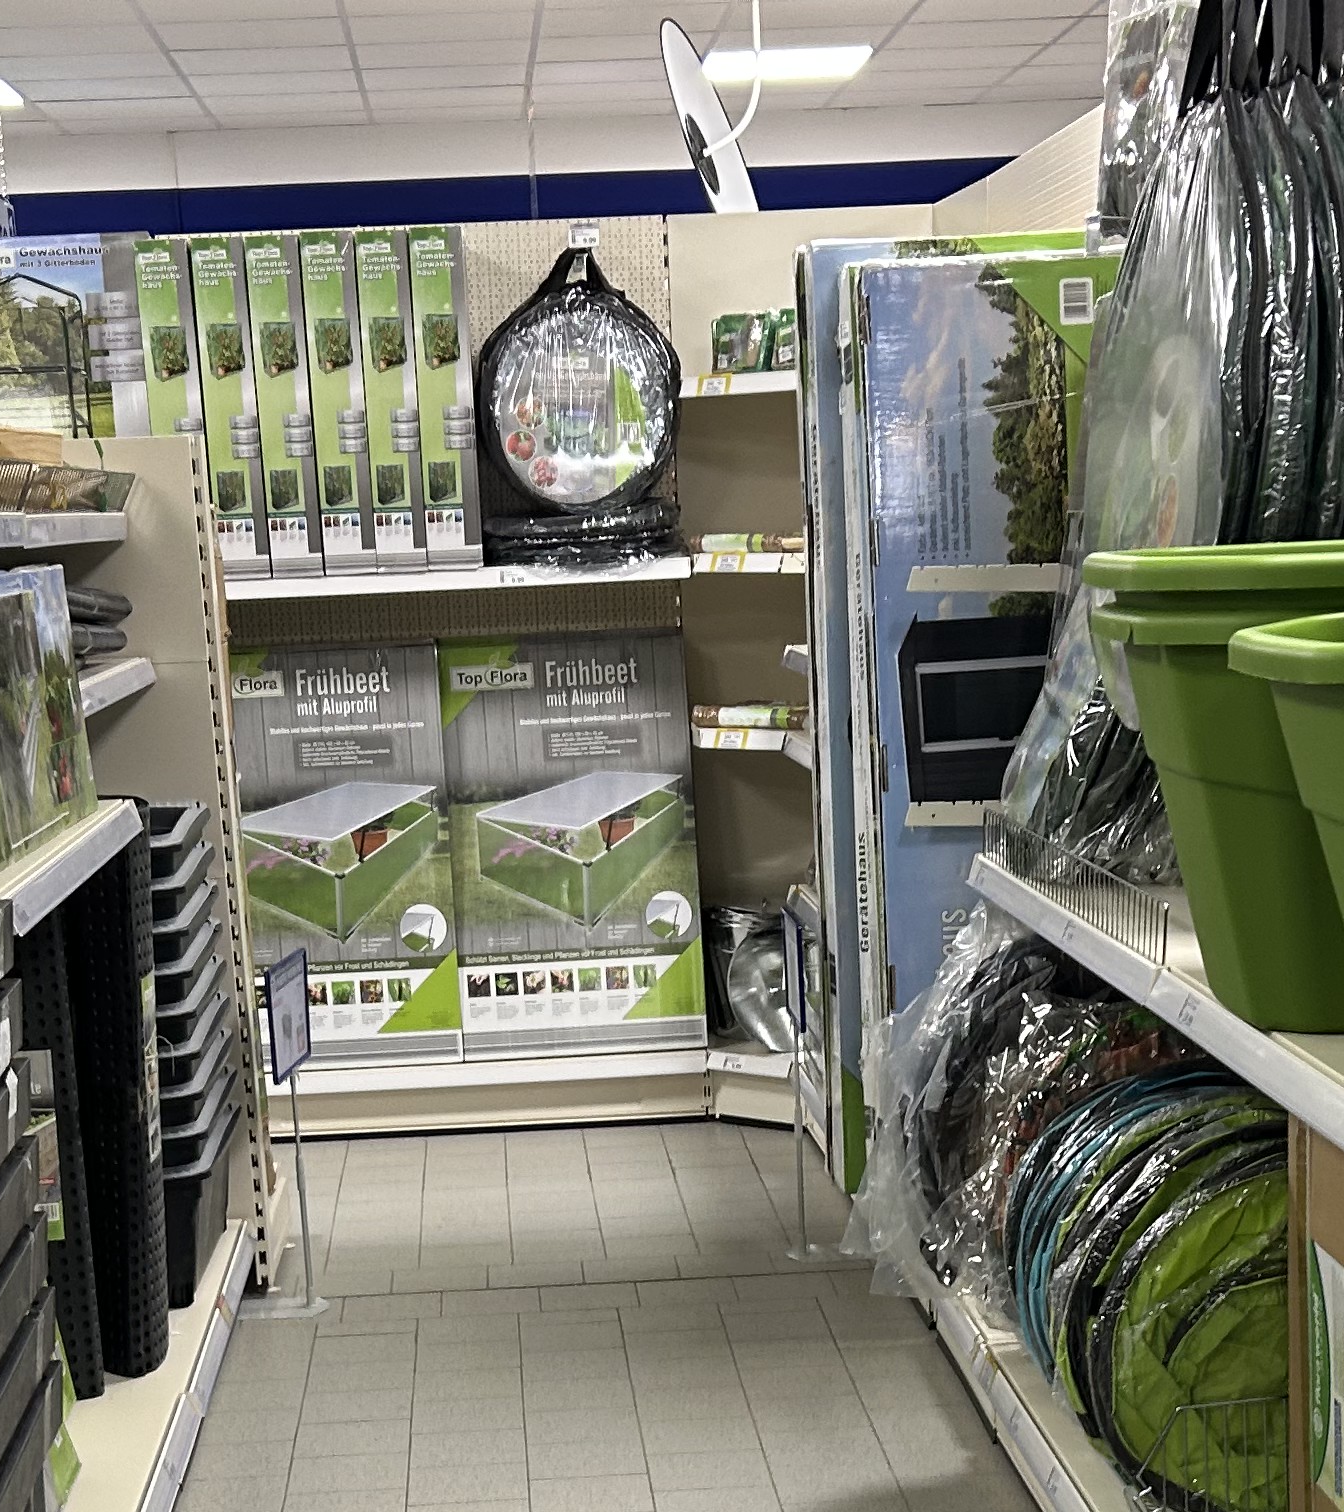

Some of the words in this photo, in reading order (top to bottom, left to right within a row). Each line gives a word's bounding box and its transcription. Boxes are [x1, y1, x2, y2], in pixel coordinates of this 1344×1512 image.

[295, 666, 391, 697] Frühbeet
[456, 673, 483, 687] Top
[490, 670, 528, 683] Flora
[545, 658, 638, 688] Frühbeet
[239, 678, 278, 692] Flora
[297, 698, 319, 717] mit
[322, 695, 377, 718] Aluprofil
[546, 689, 567, 708] mit
[572, 687, 625, 708] Aluprofil
[859, 831, 871, 953] Gerätehaus
